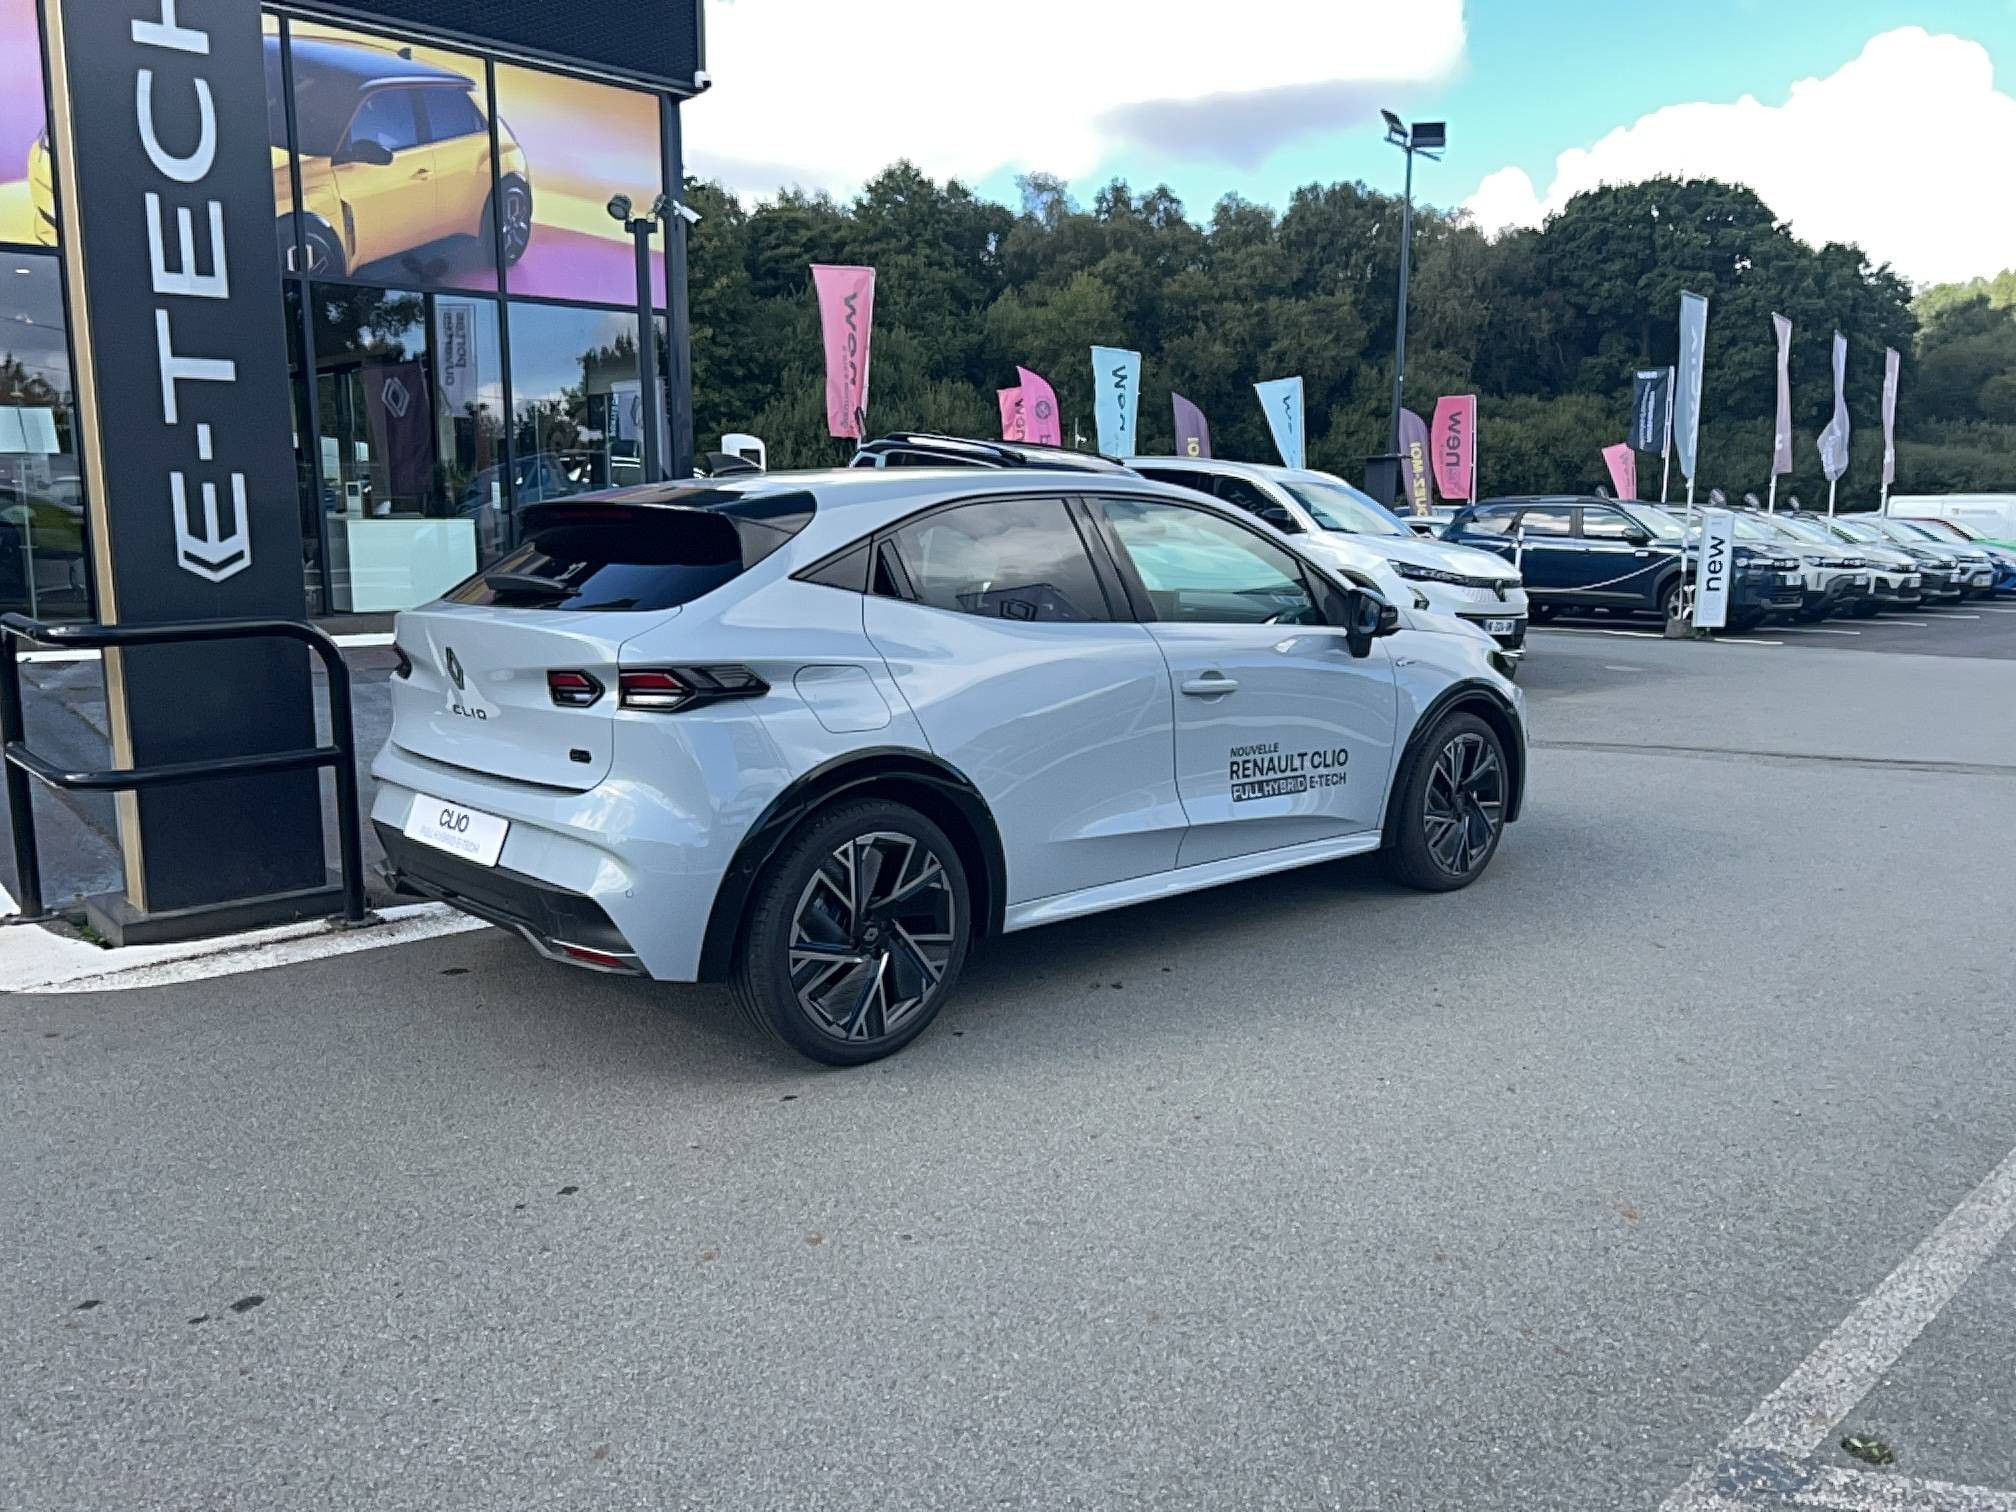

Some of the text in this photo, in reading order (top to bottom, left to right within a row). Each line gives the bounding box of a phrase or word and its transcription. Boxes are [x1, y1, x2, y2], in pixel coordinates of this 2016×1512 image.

[1705, 536, 1725, 592] new
[452, 704, 488, 720] CLIO
[1230, 742, 1280, 758] NOUVELLE
[1229, 748, 1349, 781] RENAULT CLIO
[1232, 772, 1347, 800] FULL HYBRID E-TECH
[439, 808, 470, 833] CLIO
